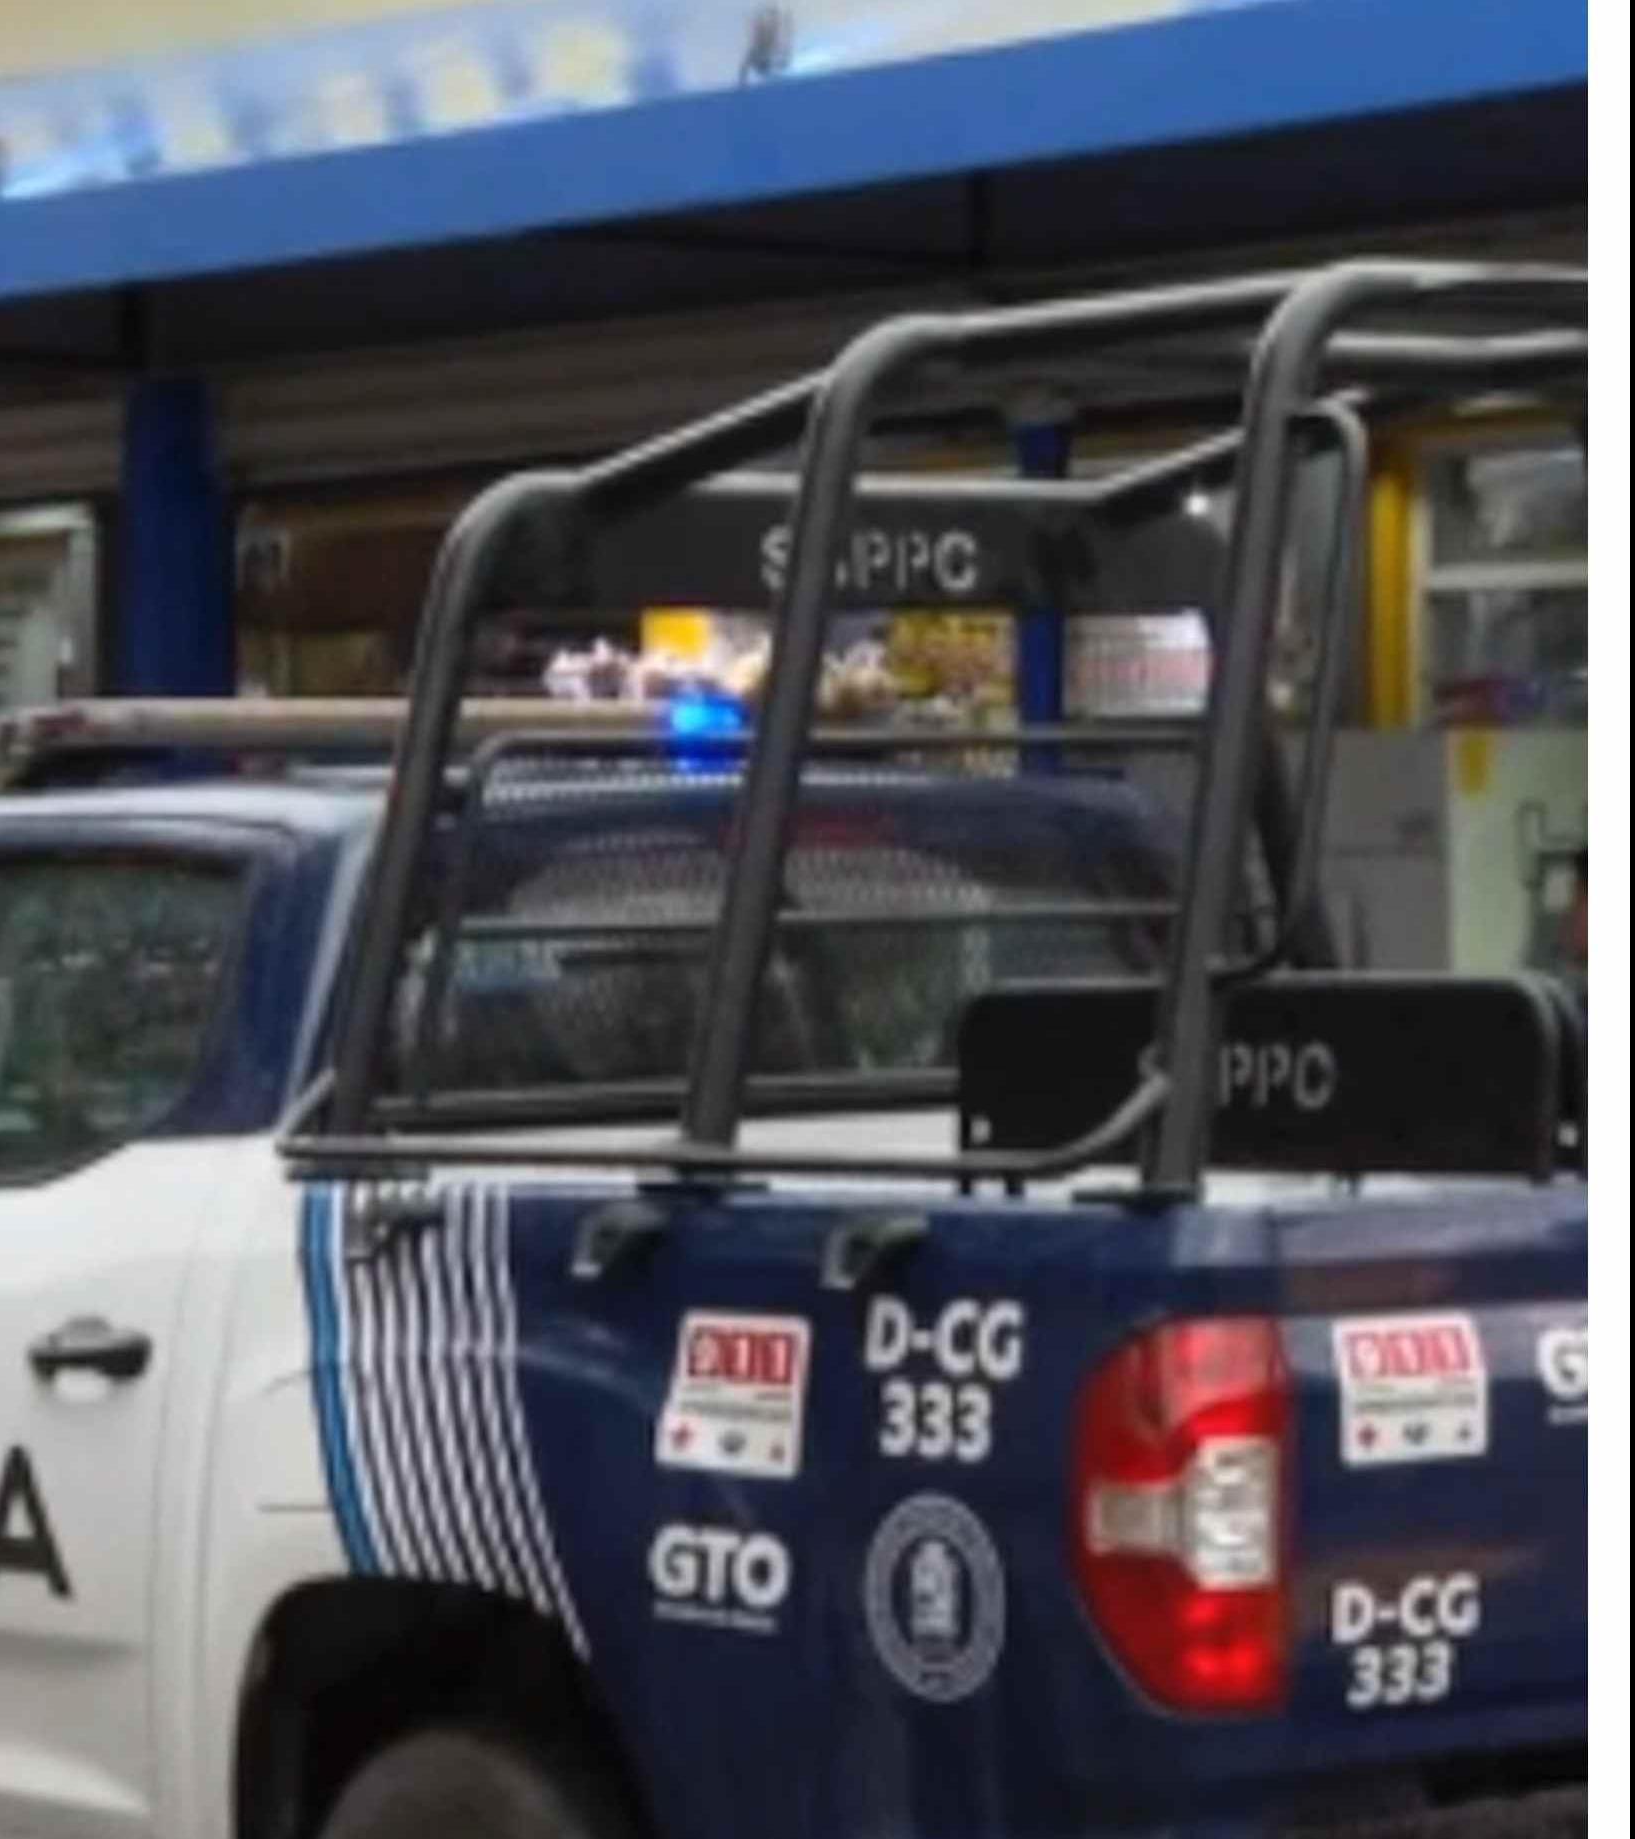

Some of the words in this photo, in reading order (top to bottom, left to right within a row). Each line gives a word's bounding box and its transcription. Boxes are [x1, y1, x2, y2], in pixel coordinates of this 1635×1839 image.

[760, 524, 978, 591] SPPC
[1136, 1041, 1337, 1110] PPC
[866, 1295, 1024, 1380] D-CG
[879, 1377, 993, 1463] 333
[647, 1522, 792, 1607] GTO
[1331, 1570, 1482, 1644] D-CG
[1345, 1640, 1451, 1711] 333
